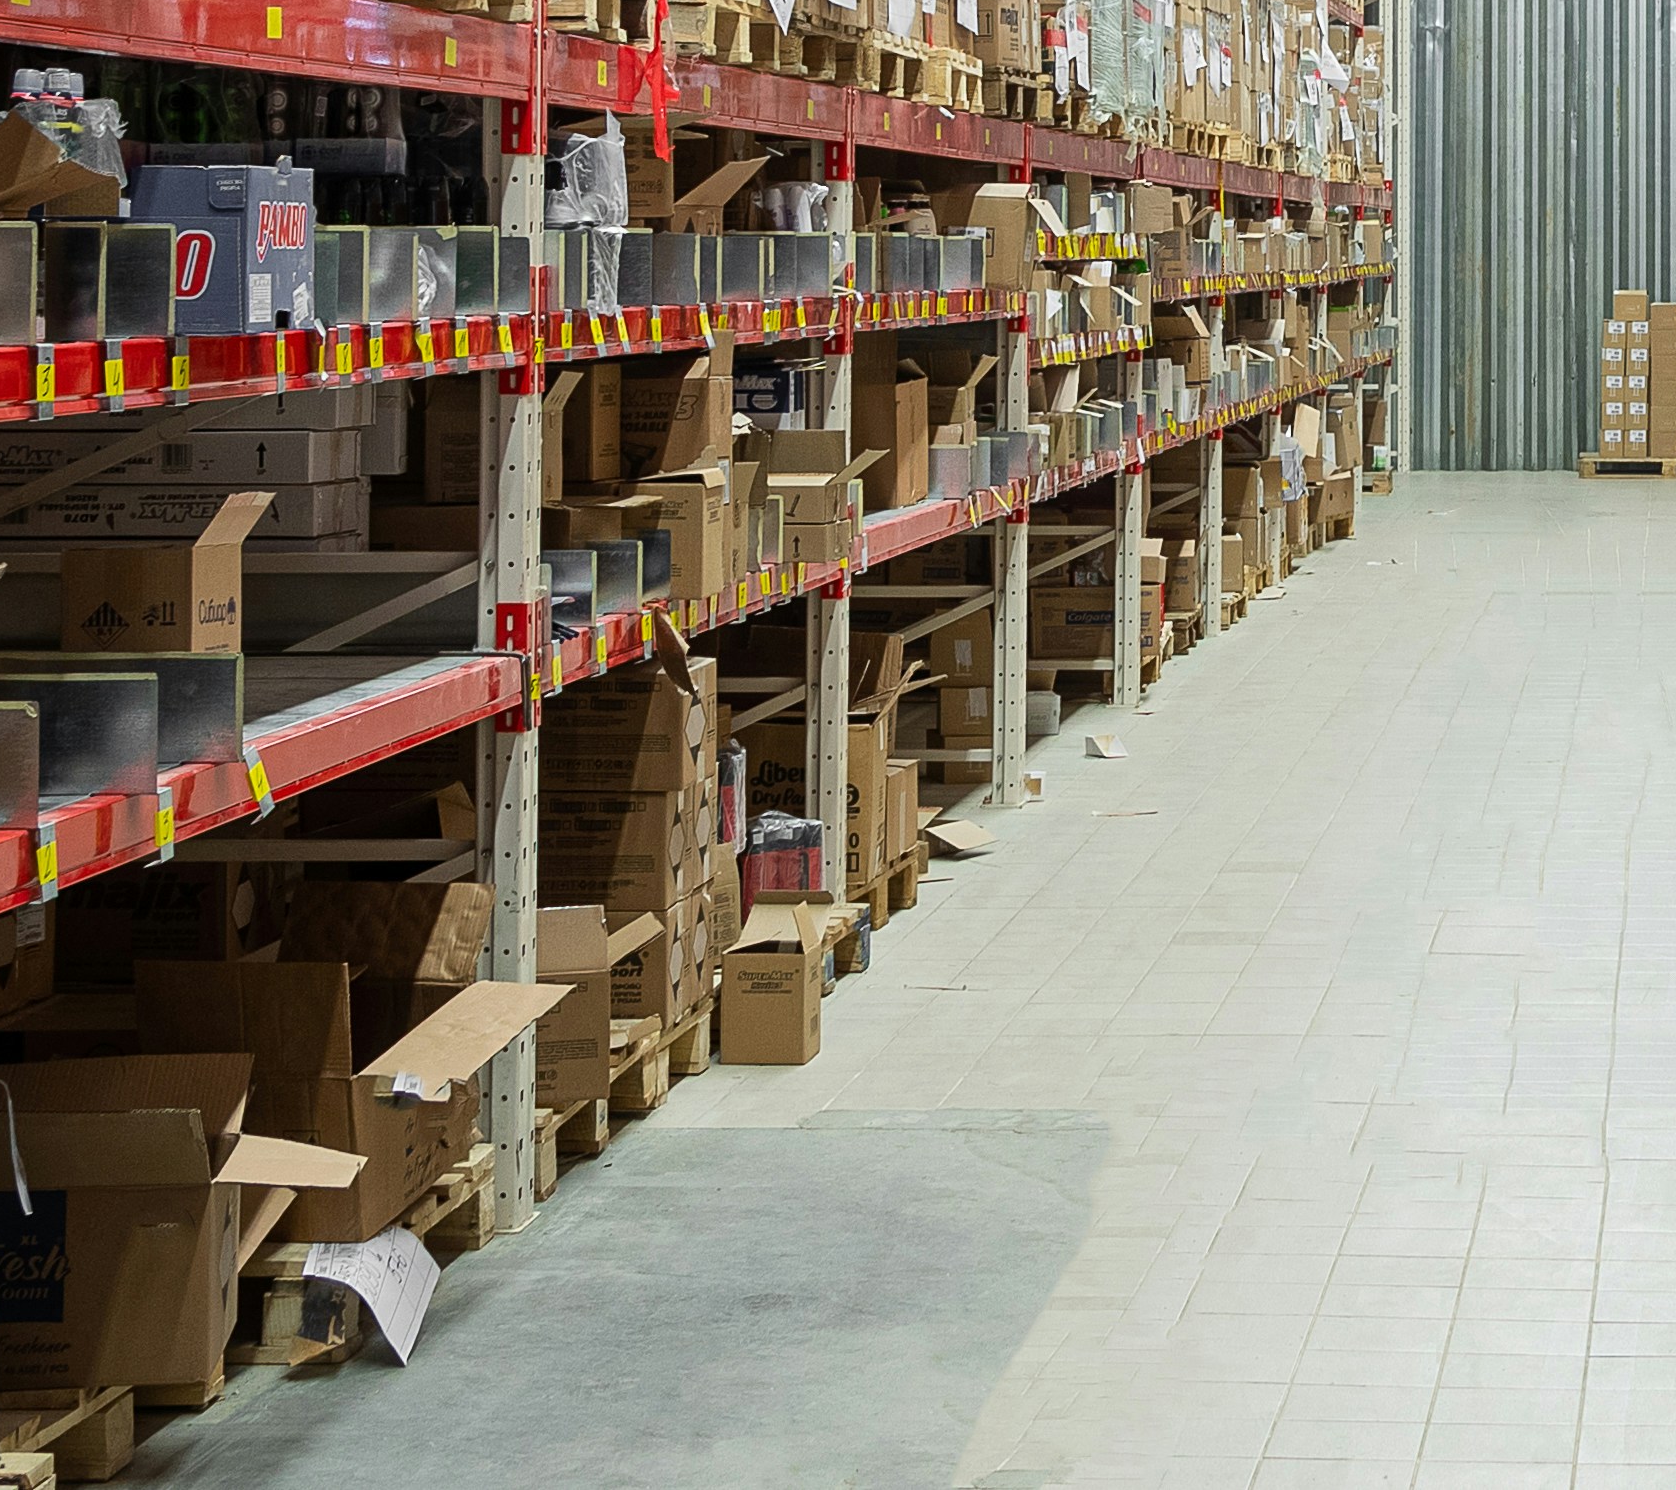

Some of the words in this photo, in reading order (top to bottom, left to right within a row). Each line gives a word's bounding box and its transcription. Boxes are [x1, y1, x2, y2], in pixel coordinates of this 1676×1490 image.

[256, 201, 308, 262] PAMBO
[39, 358, 50, 397] 3
[111, 364, 121, 392] 4
[1068, 612, 1112, 623] Colgate
